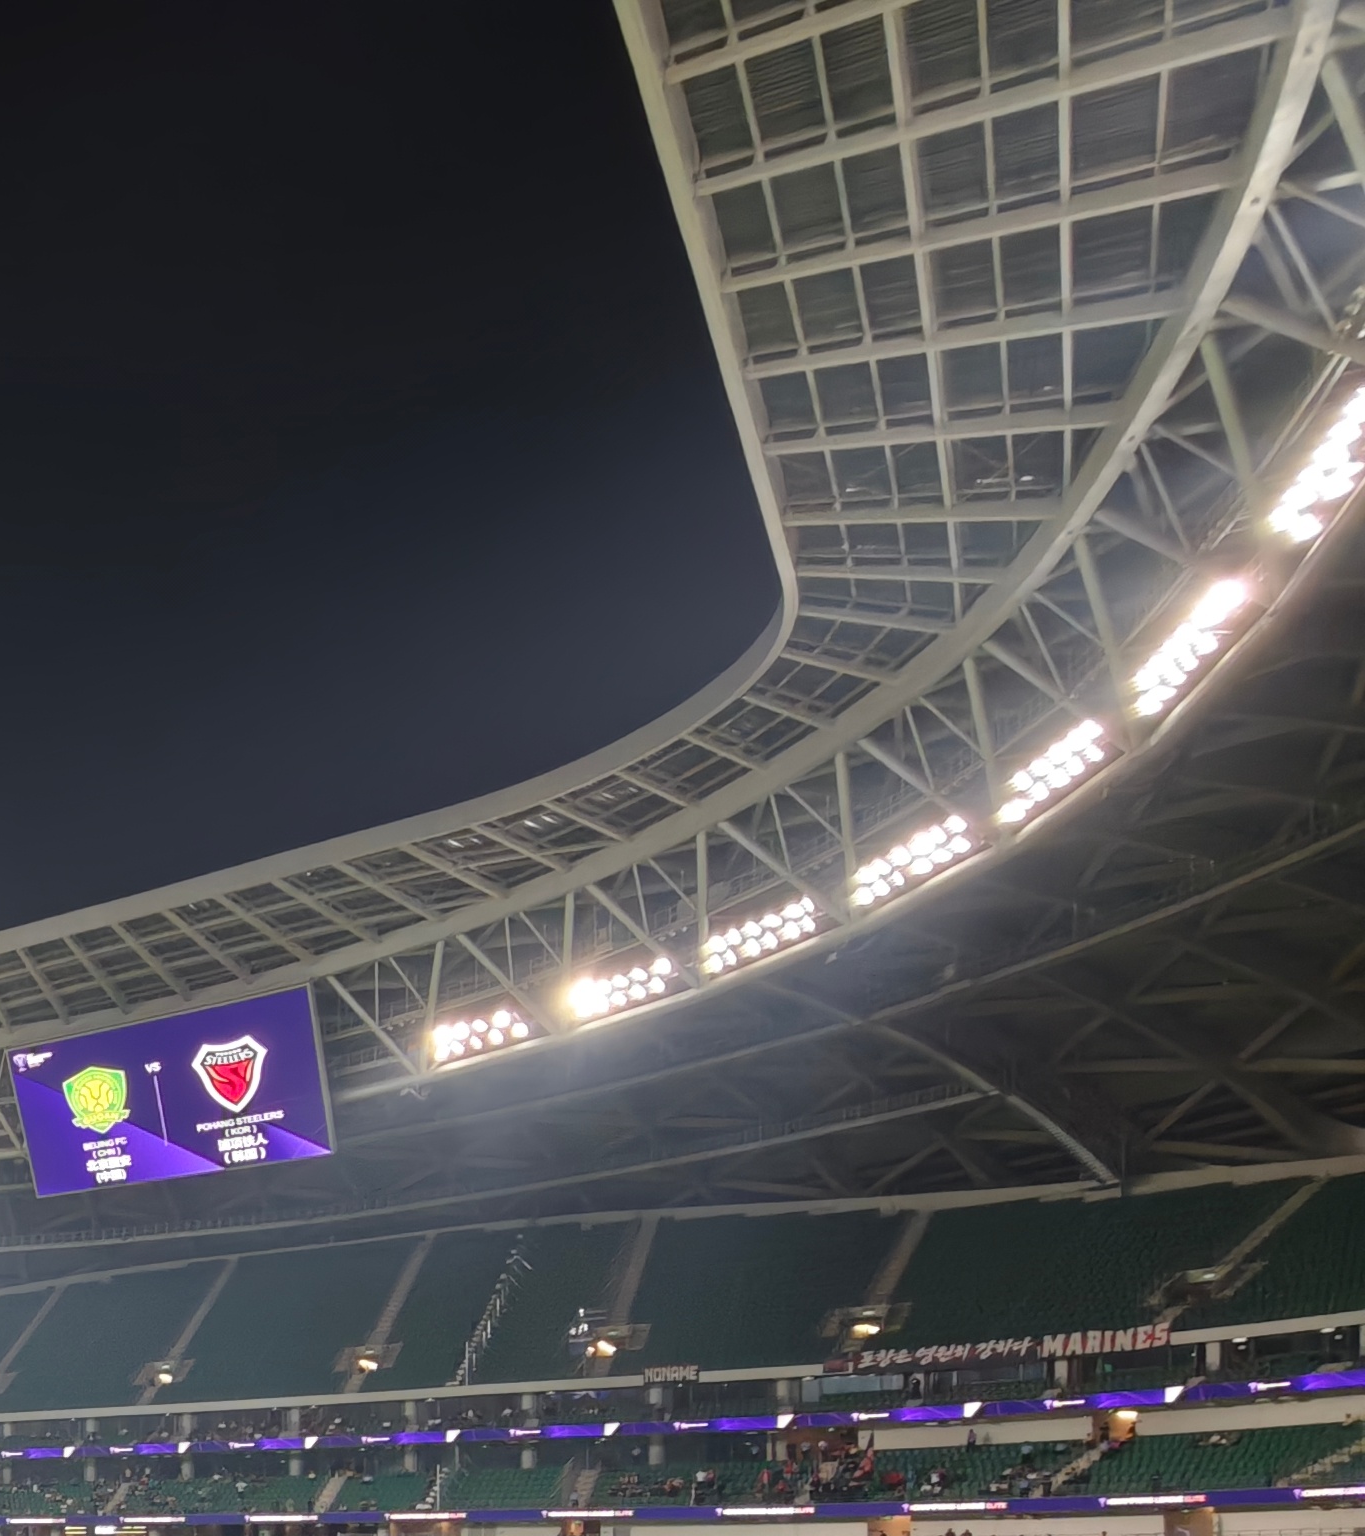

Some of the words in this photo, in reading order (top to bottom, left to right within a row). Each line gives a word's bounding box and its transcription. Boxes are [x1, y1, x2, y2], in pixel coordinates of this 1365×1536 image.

[145, 1062, 161, 1073] VS
[857, 1349, 912, 1369] 포항은
[915, 1343, 971, 1365] 영원히
[975, 1336, 1032, 1360] 강하다
[1042, 1322, 1170, 1359] MARINES
[645, 1364, 698, 1383] NONAME
